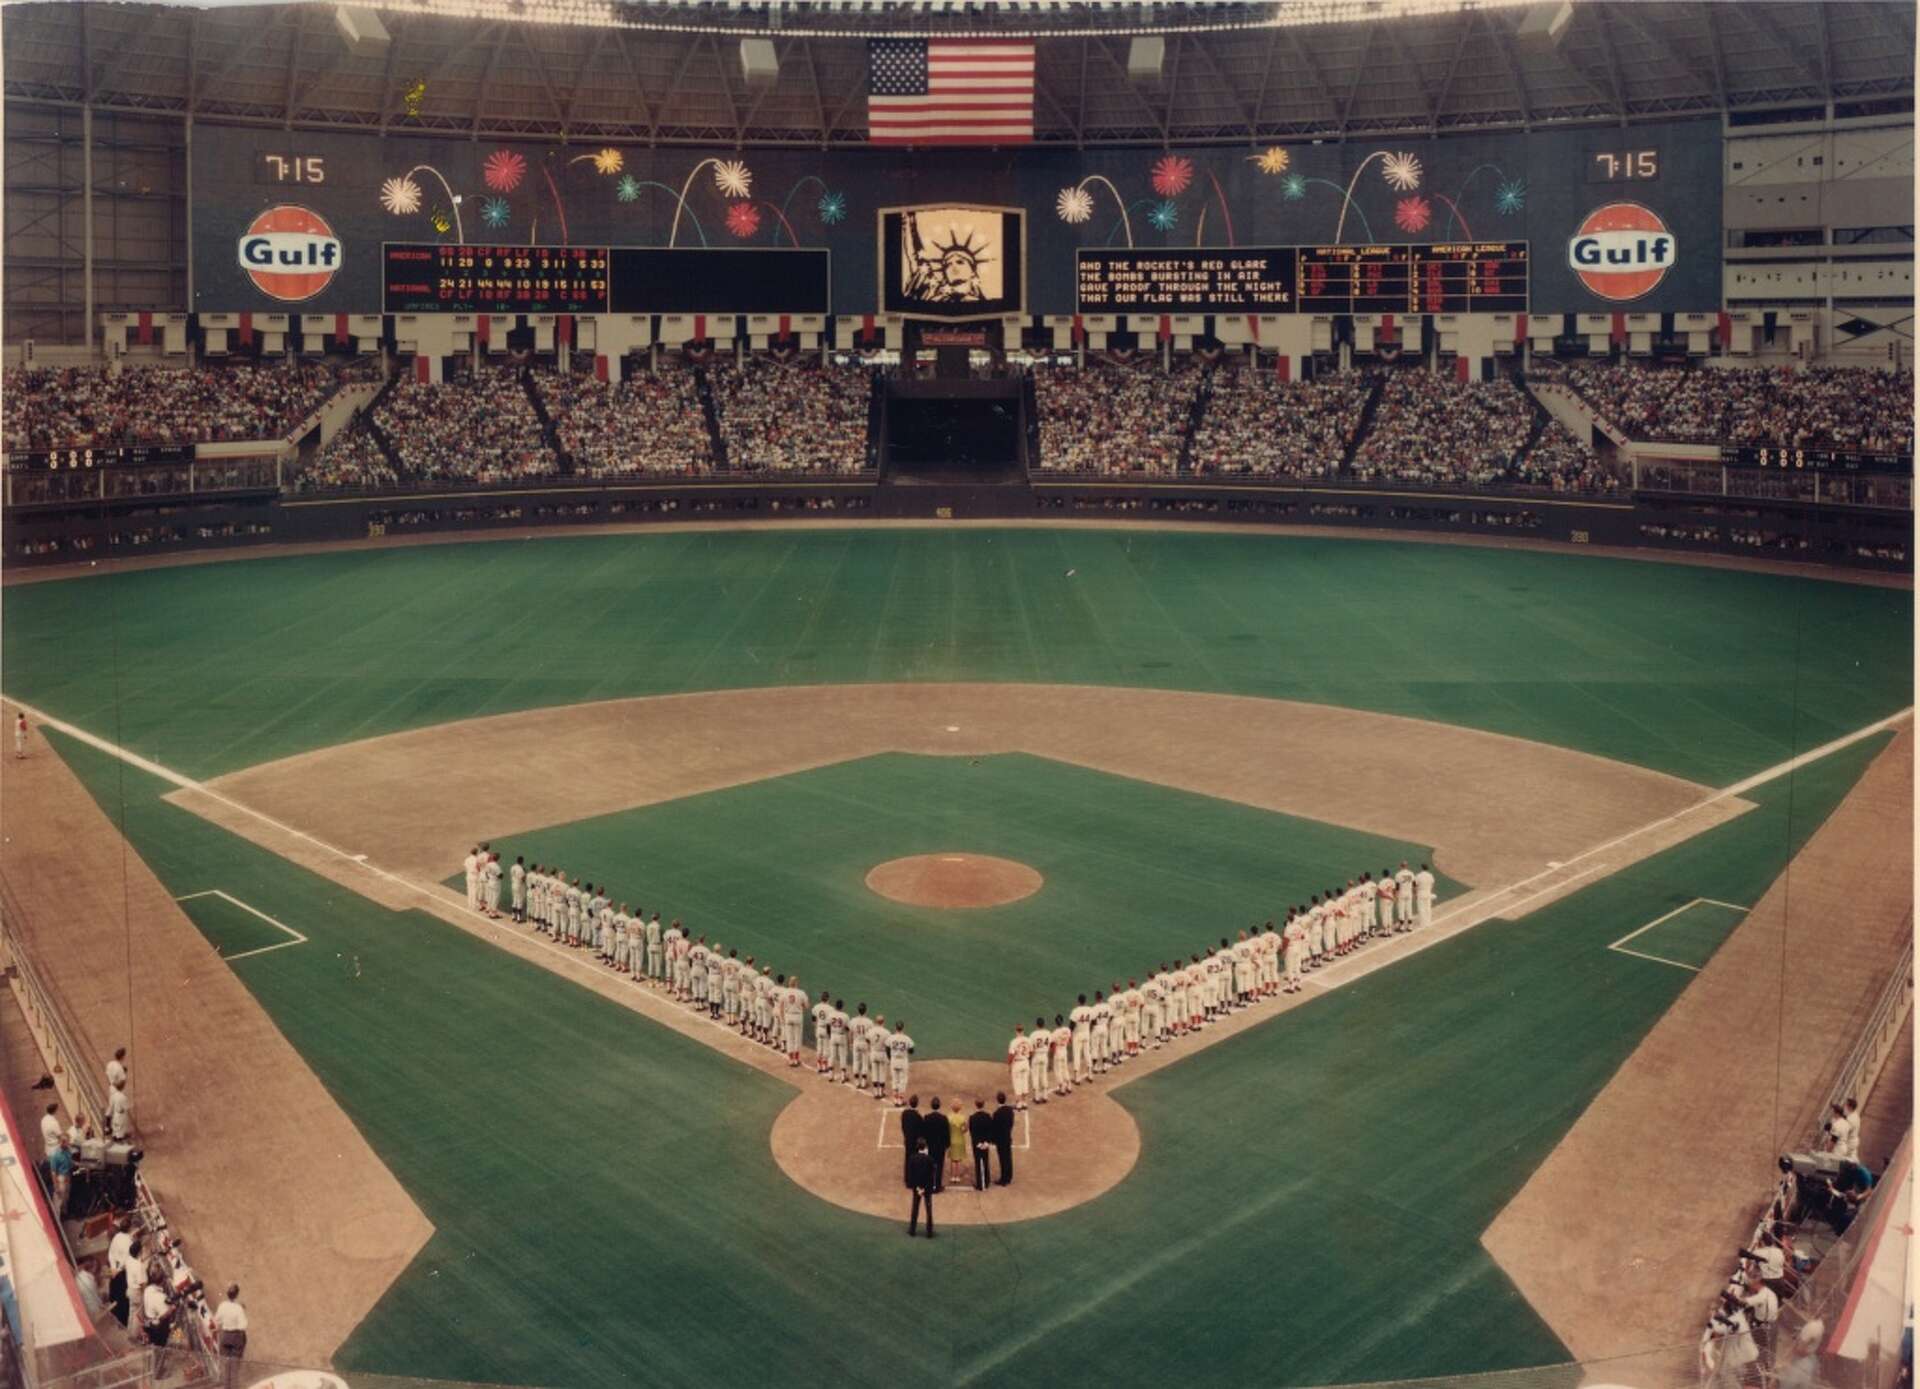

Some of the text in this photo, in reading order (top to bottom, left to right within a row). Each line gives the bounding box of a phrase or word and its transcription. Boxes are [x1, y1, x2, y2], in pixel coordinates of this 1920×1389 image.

[265, 155, 325, 183] 7:15
[1596, 151, 1657, 178] 7:15
[244, 238, 337, 266] Gulf
[1574, 237, 1669, 264] Gulf
[441, 258, 453, 267] 11
[554, 259, 566, 269] 11
[1080, 260, 1267, 270] AND THE ROCKET'S RED GLARE
[1080, 271, 1259, 281] THE BOMBS BURSTING IN AIR
[440, 279, 454, 288] 24
[459, 279, 472, 289] 21
[517, 280, 531, 289] 10
[573, 281, 586, 289] 11
[1080, 282, 1281, 292] GAVE PROOF THROUGH THE NIGHT
[1080, 292, 1289, 303] THAT OUR FLAG WAS STILL THERE
